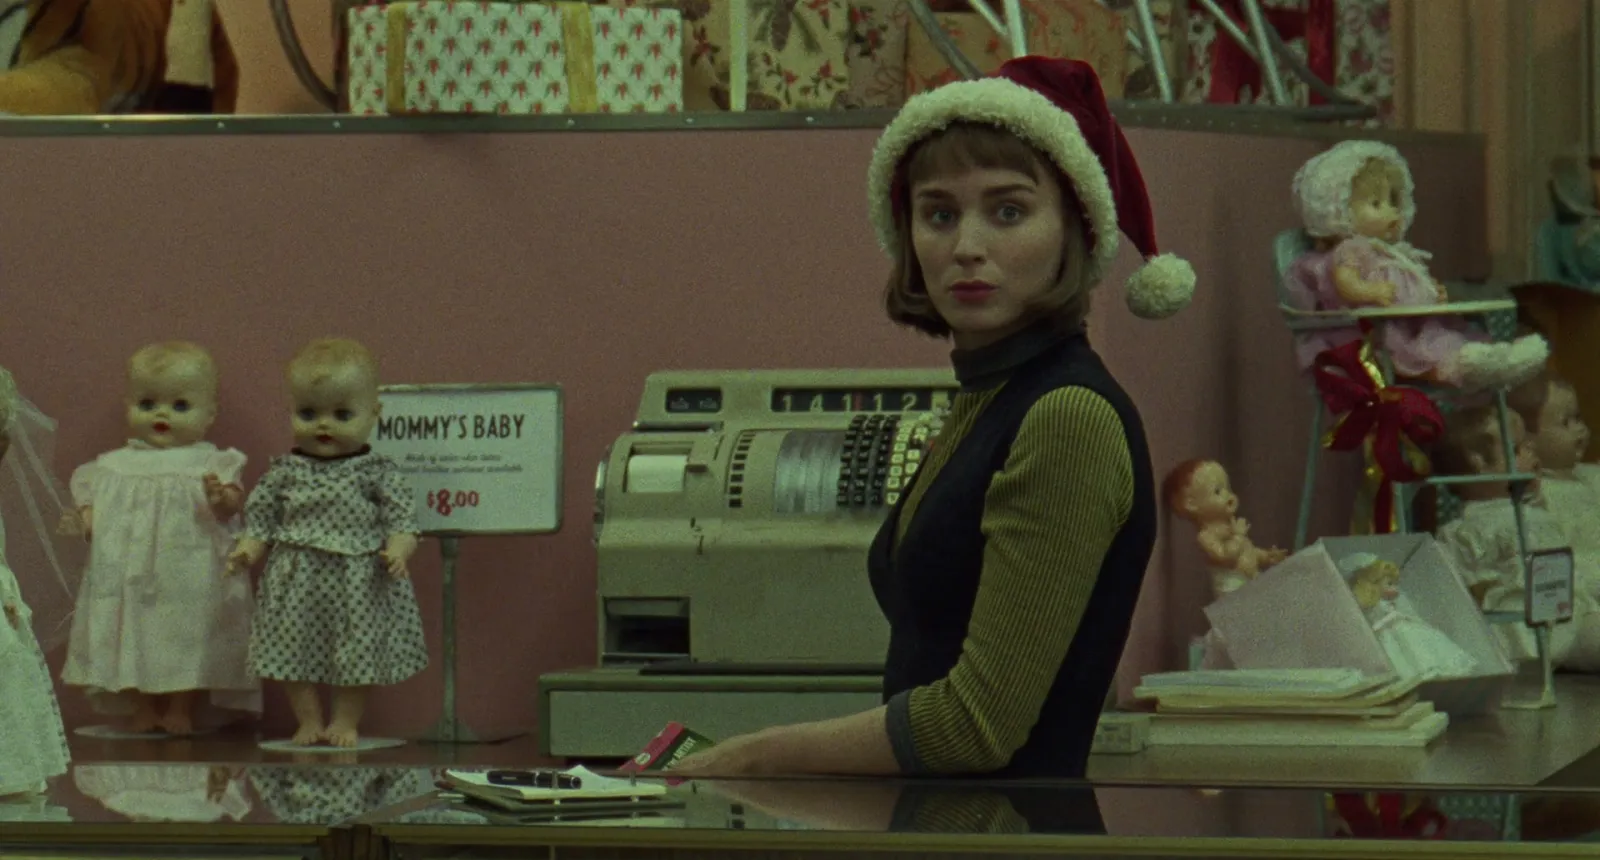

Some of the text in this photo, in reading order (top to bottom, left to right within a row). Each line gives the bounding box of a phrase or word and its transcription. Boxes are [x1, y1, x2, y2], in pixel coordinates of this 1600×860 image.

[377, 414, 525, 440] MOMMY'S BABY
[427, 489, 479, 516] $8.00
